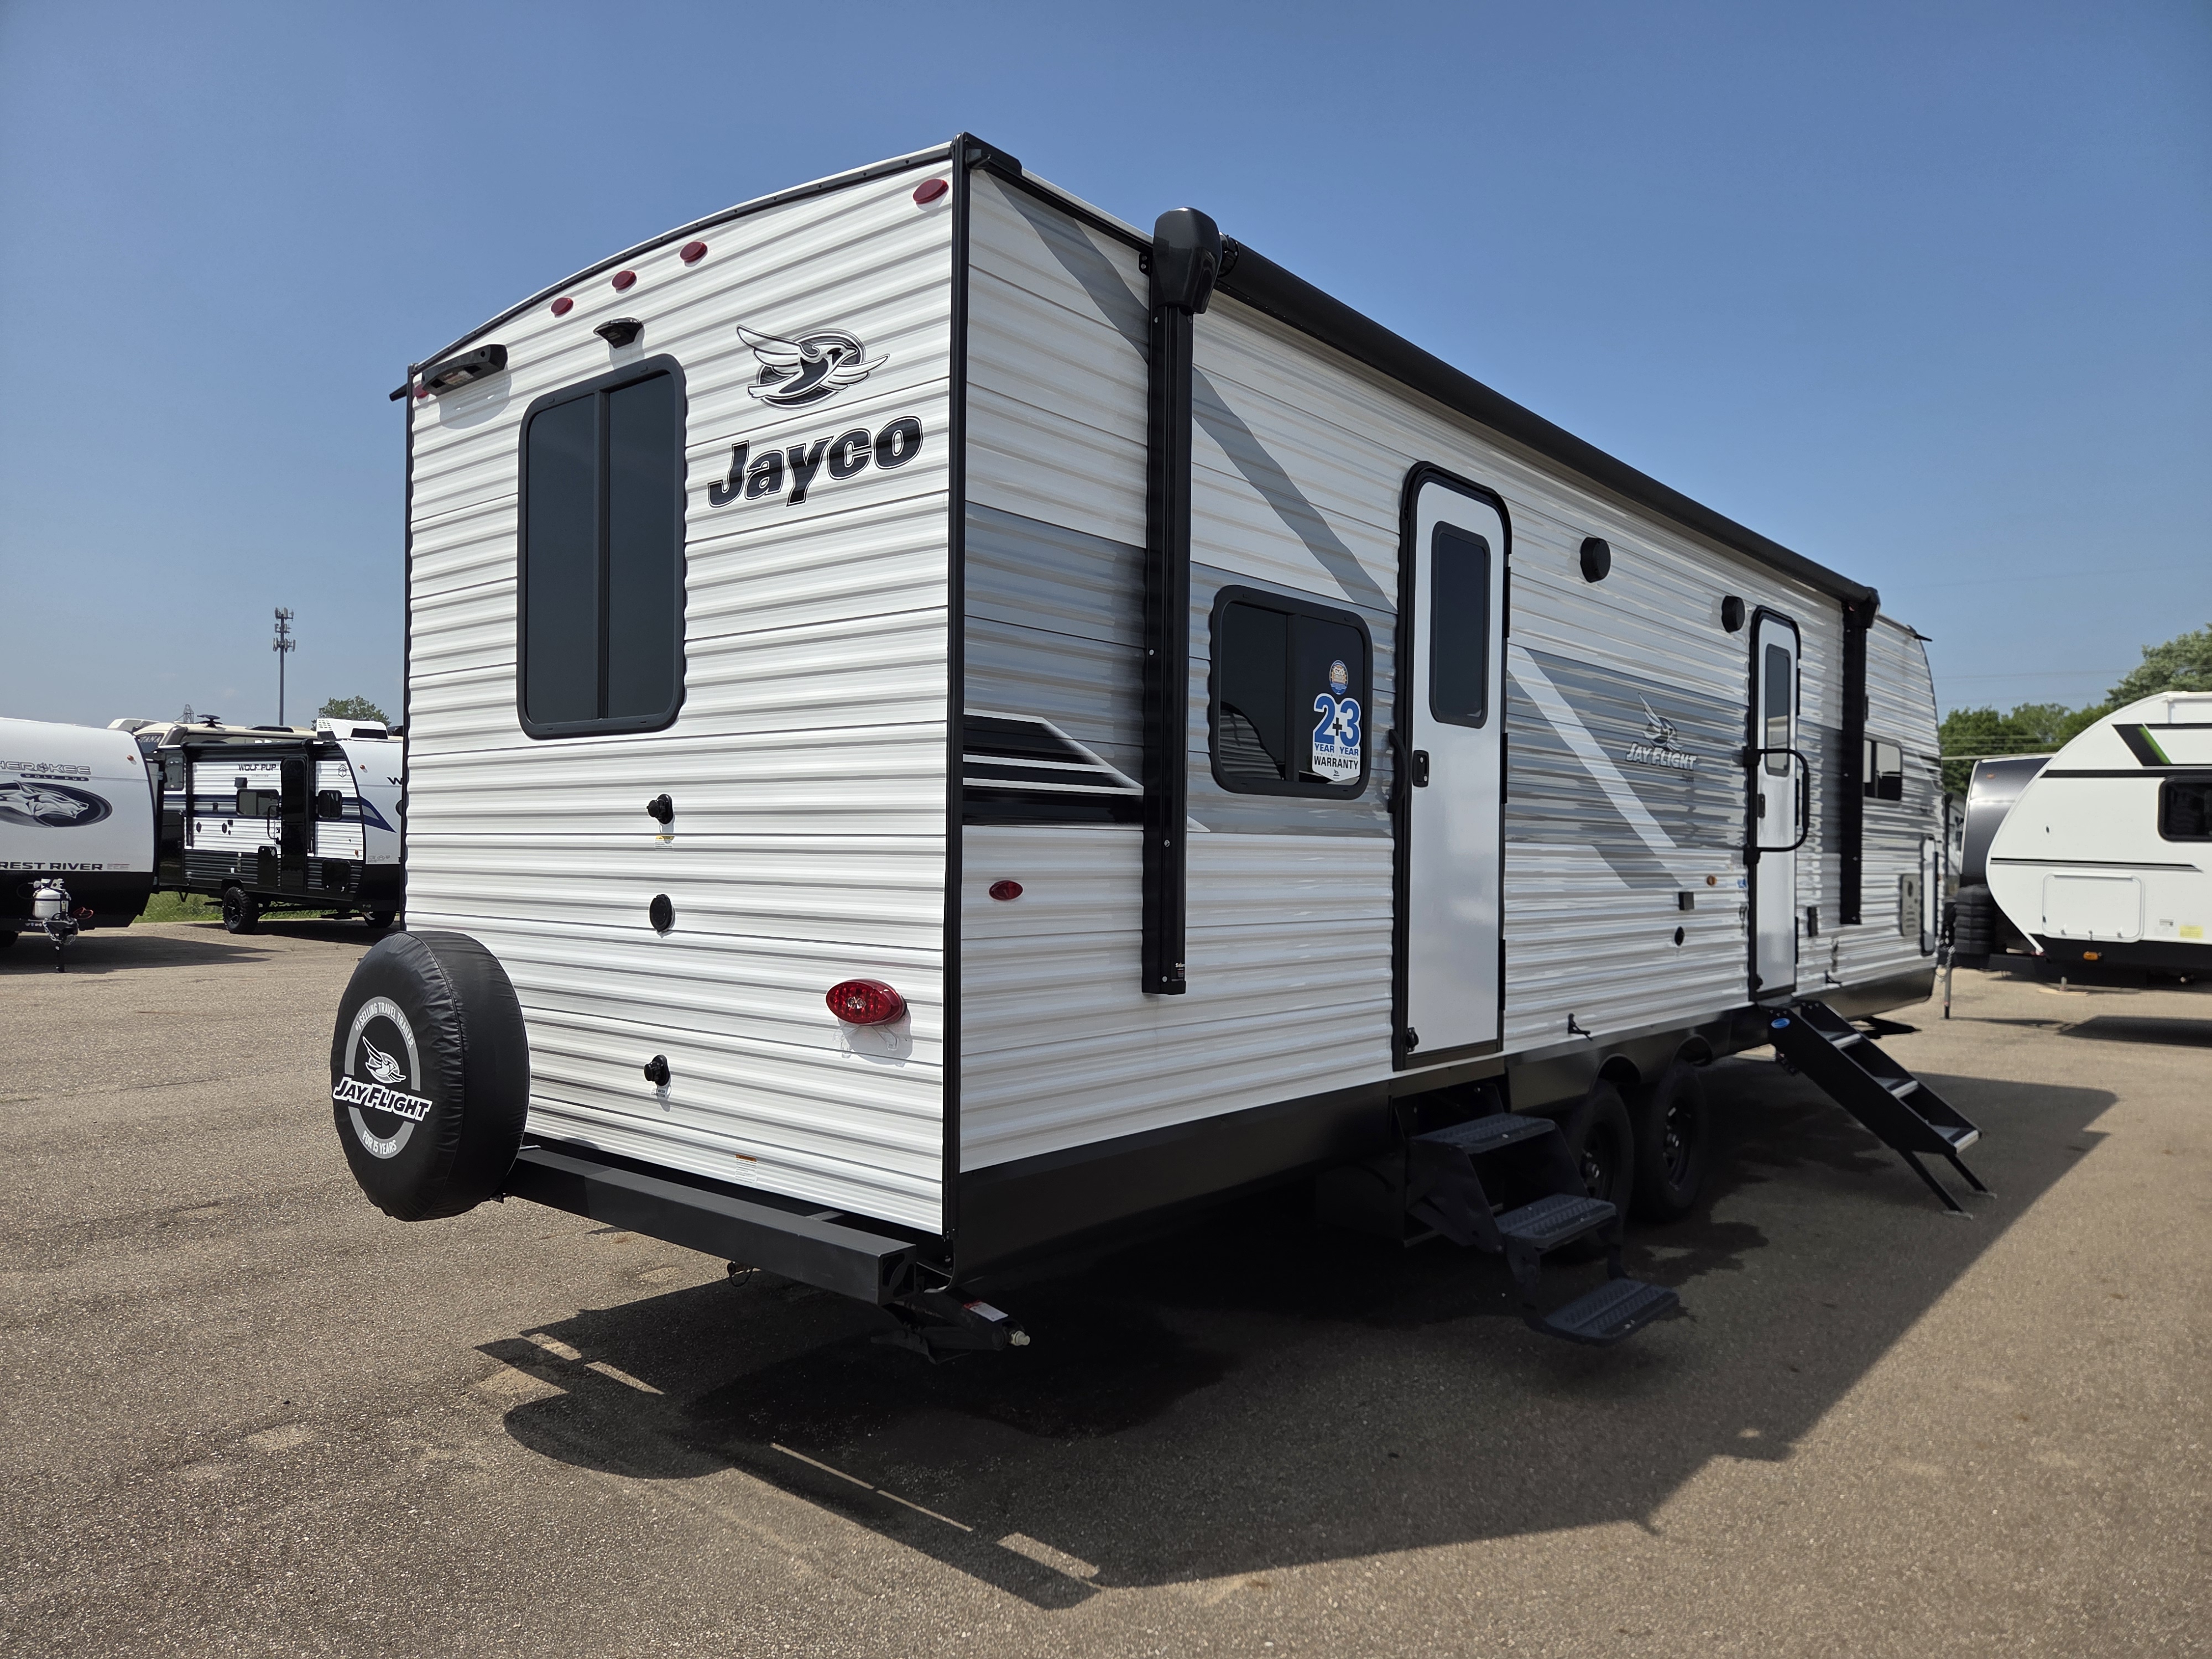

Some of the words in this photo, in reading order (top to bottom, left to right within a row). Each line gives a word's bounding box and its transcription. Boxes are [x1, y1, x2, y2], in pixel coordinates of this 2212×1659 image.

[707, 415, 924, 508] Jayco
[1314, 743, 1334, 753] YEAR
[1339, 747, 1359, 757] YEAR
[1314, 755, 1359, 770] WARRANTY
[50, 862, 103, 870] RIVER
[359, 1003, 377, 1026] SELLING
[378, 1002, 396, 1020] TRAVEL
[397, 1011, 414, 1048] TRAILER
[362, 1130, 373, 1150] FOR
[373, 1140, 379, 1153] 15
[379, 1139, 397, 1155] YEARS
